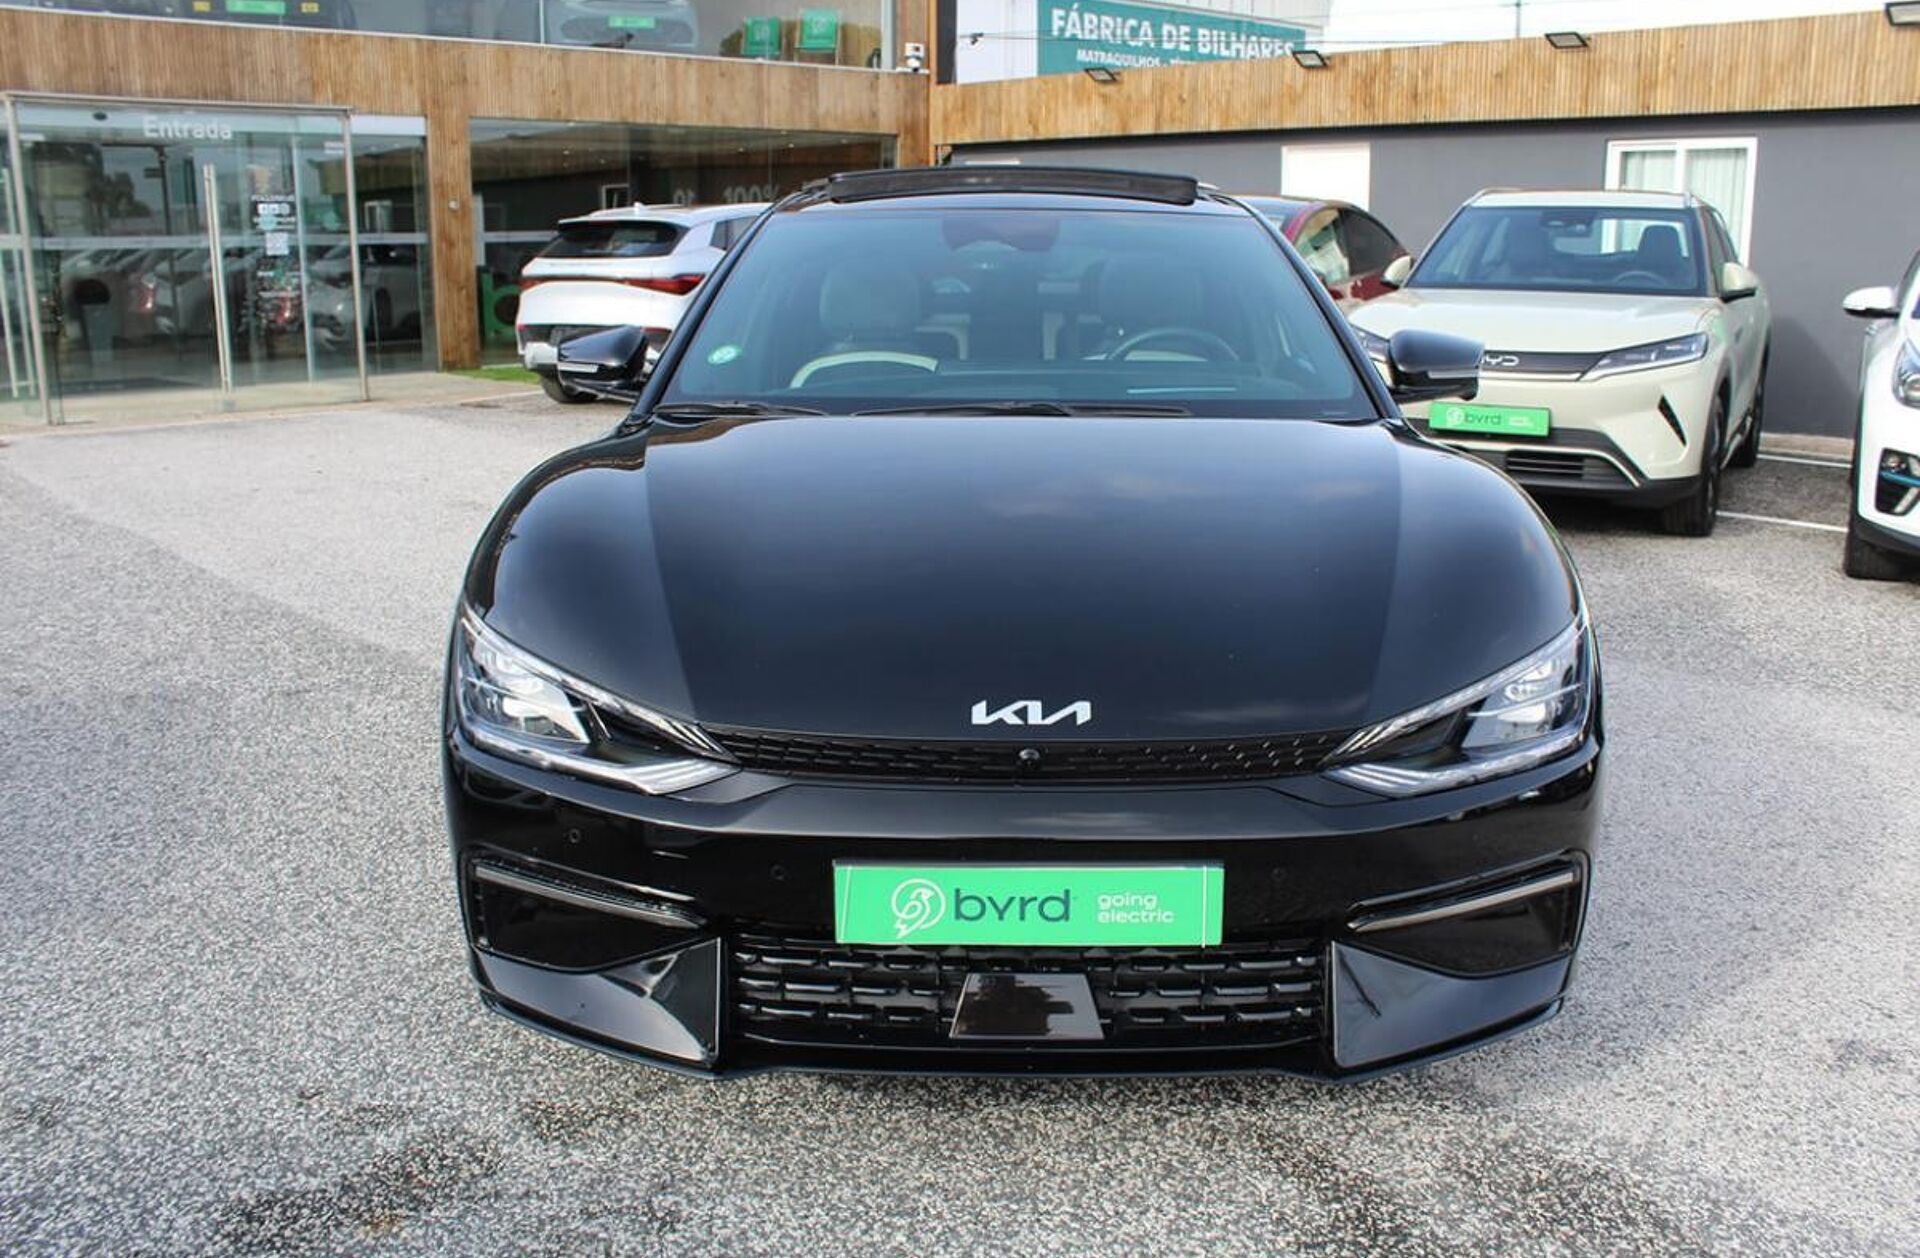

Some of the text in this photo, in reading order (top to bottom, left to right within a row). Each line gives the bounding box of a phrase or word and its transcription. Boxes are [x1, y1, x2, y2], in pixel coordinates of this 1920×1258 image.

[1051, 2, 1295, 59] FÁBRICA DE BILHARES
[143, 115, 232, 139] Entrada
[1480, 354, 1519, 366] YD
[1464, 410, 1502, 426] byrd
[971, 700, 1092, 725] KIA
[954, 887, 1071, 923] byrd
[1098, 892, 1158, 909] going
[1097, 909, 1175, 924] electric
